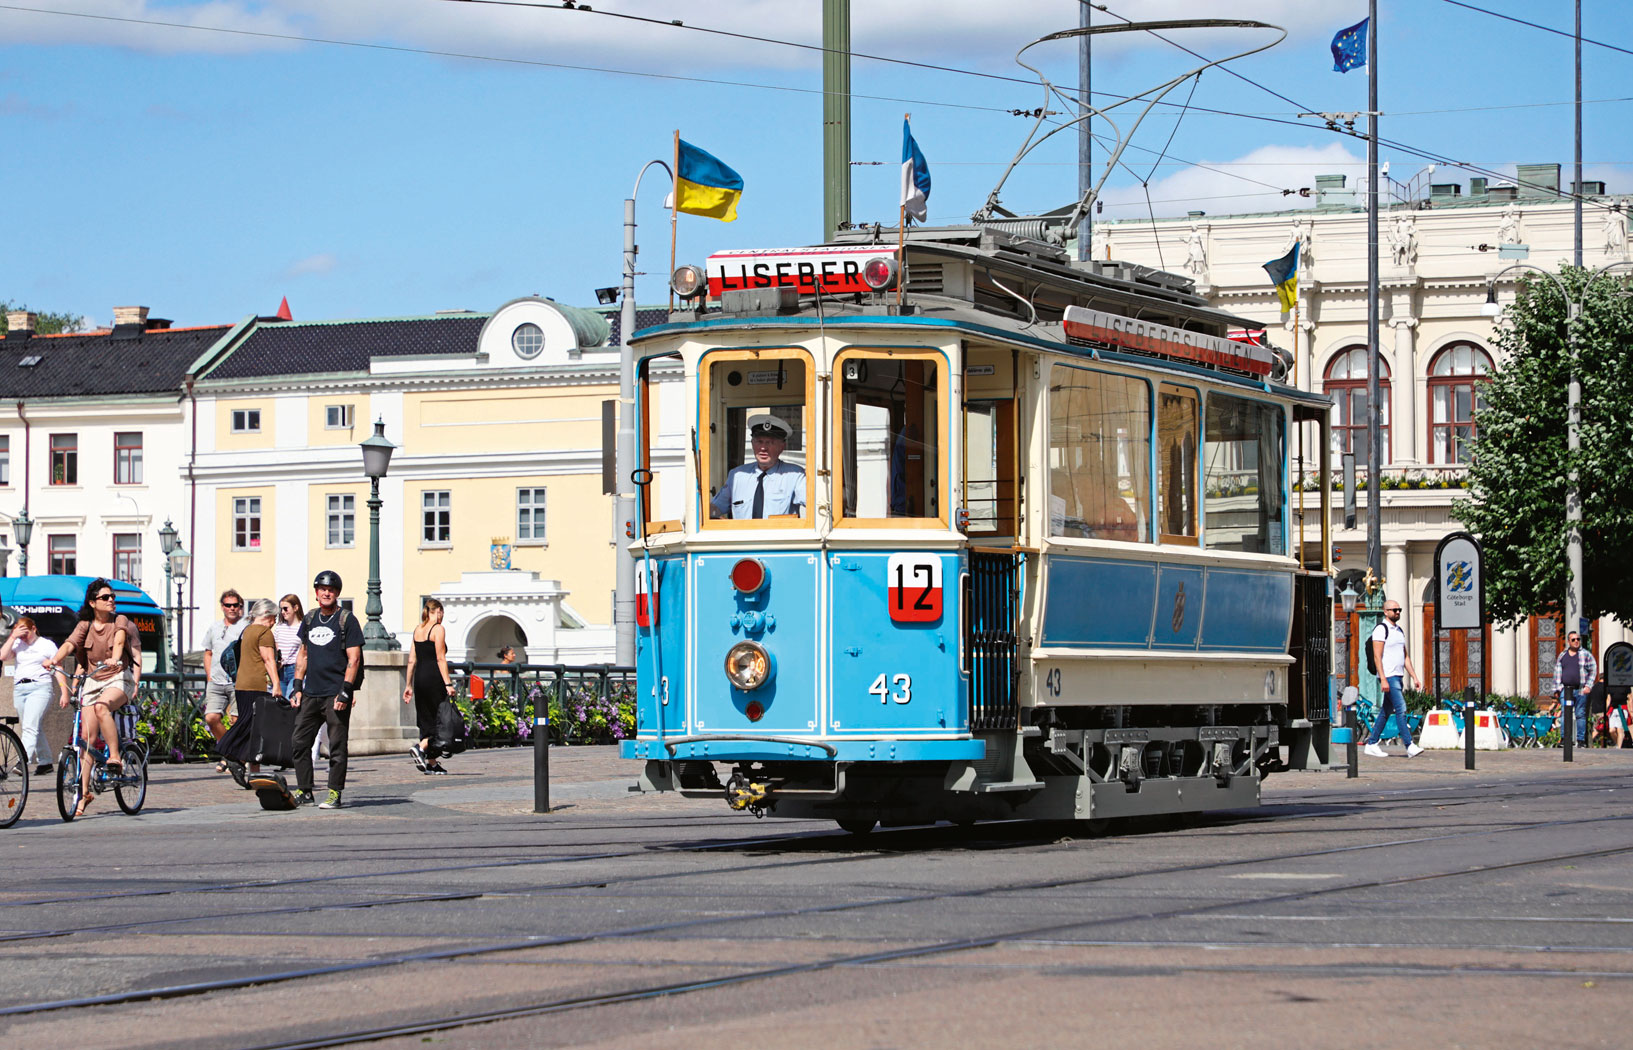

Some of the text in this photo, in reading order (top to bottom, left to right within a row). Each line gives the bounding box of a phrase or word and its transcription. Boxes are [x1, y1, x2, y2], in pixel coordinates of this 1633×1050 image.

[720, 260, 860, 289] LISEBER
[1091, 314, 1252, 370] LISEBERGSLINJEN
[849, 366, 855, 377] 3
[895, 564, 933, 610] 12
[24, 606, 63, 614] HYBRID
[651, 675, 669, 706] 3
[868, 673, 912, 705] 43
[1046, 668, 1061, 697] 43
